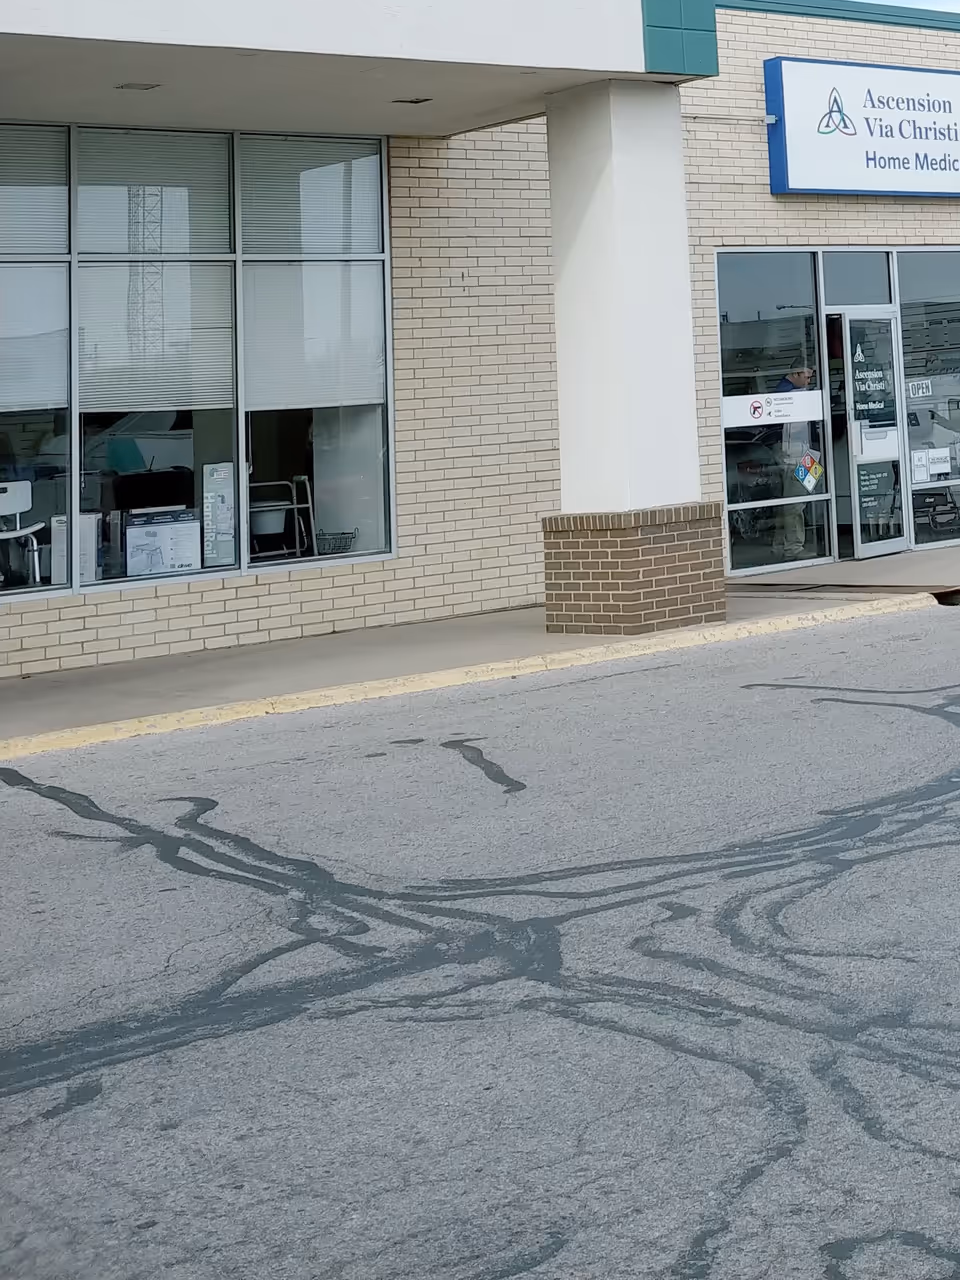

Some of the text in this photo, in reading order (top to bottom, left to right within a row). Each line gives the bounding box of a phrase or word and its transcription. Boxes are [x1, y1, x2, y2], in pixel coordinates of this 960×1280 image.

[862, 88, 953, 114] Ascension
[863, 116, 960, 142] Via Christi
[865, 150, 910, 170] Home
[911, 381, 930, 396] OPEN
[204, 492, 217, 558] HandiRail
